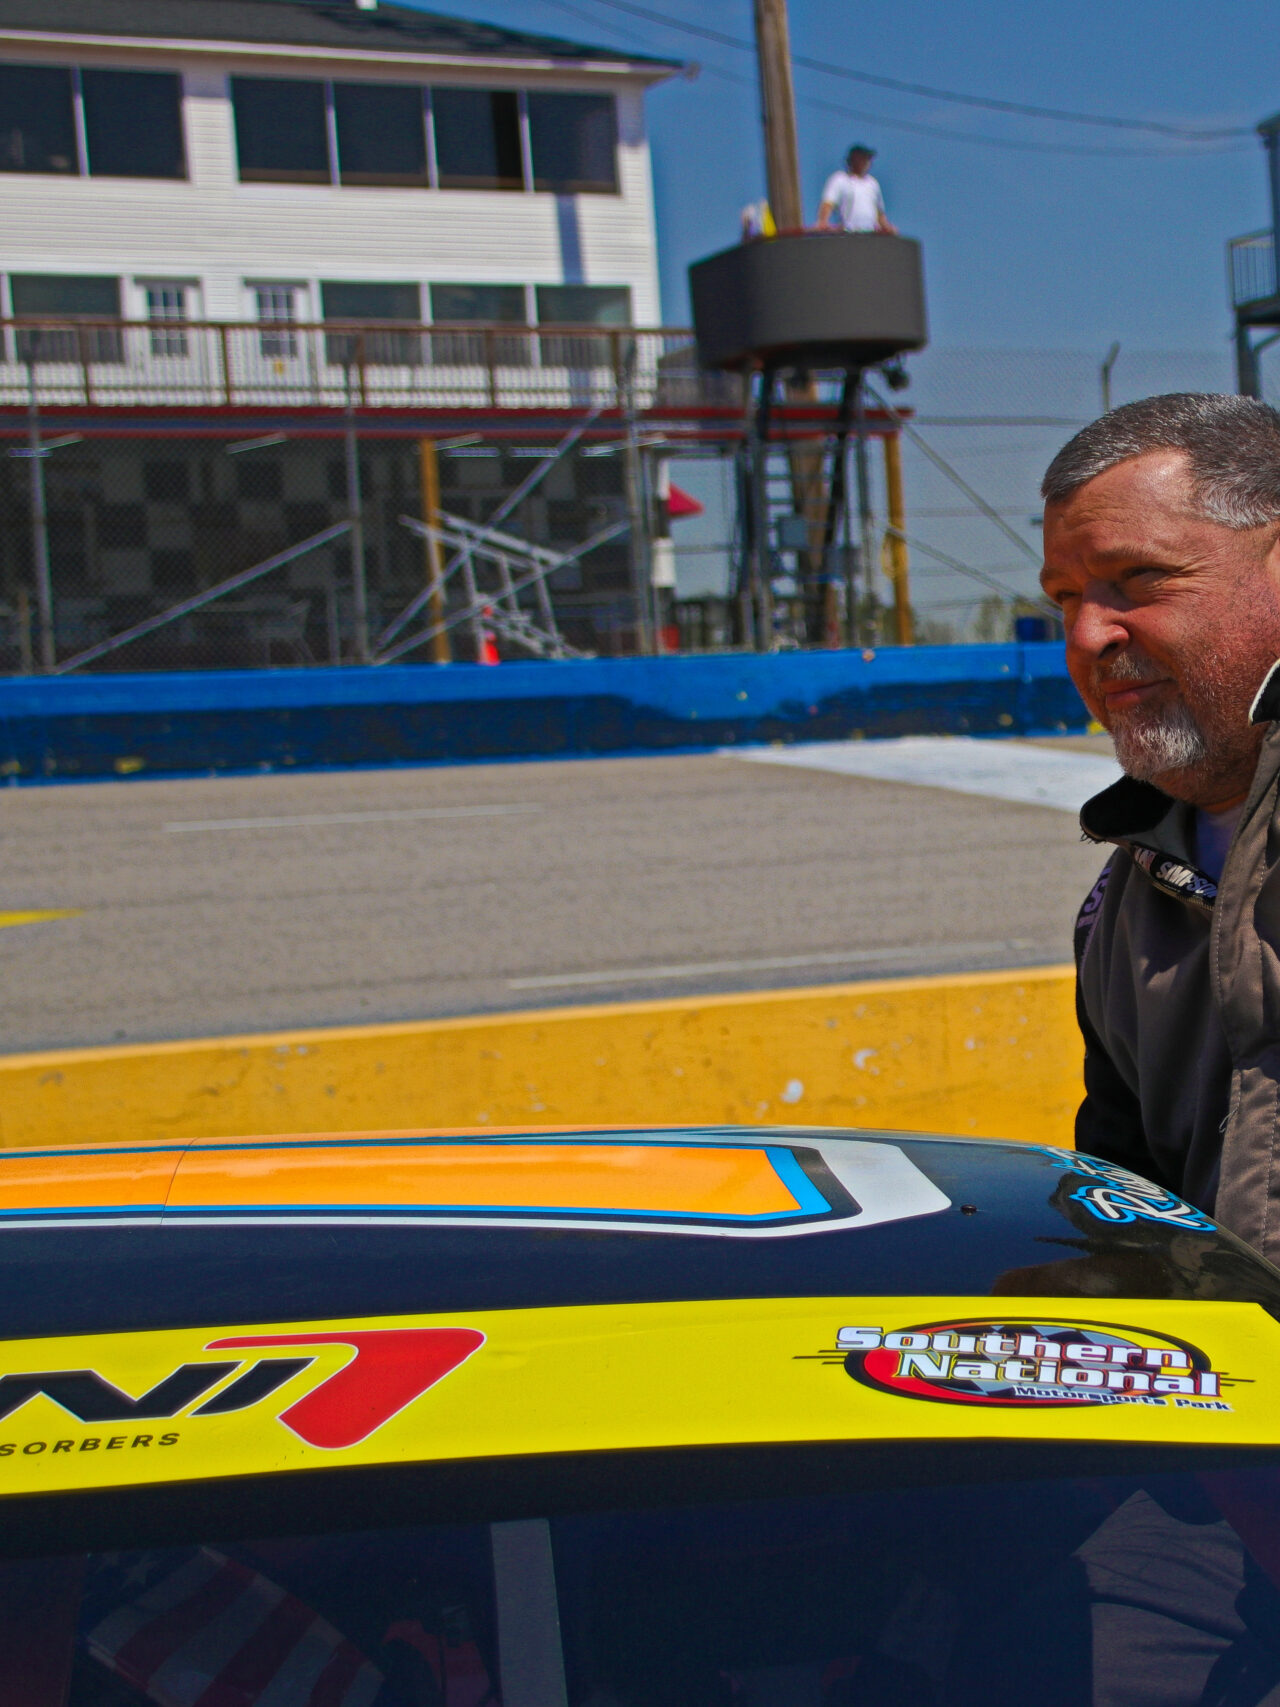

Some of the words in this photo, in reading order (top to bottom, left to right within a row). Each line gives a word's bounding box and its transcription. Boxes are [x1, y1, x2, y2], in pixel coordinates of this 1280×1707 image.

[1155, 860, 1218, 898] SIMPSO
[836, 1326, 1192, 1368] Southern
[894, 1351, 1220, 1397] National
[1014, 1385, 1167, 1406] Motorsports
[1175, 1398, 1230, 1412] Park
[0, 1432, 181, 1457] SORBERS
